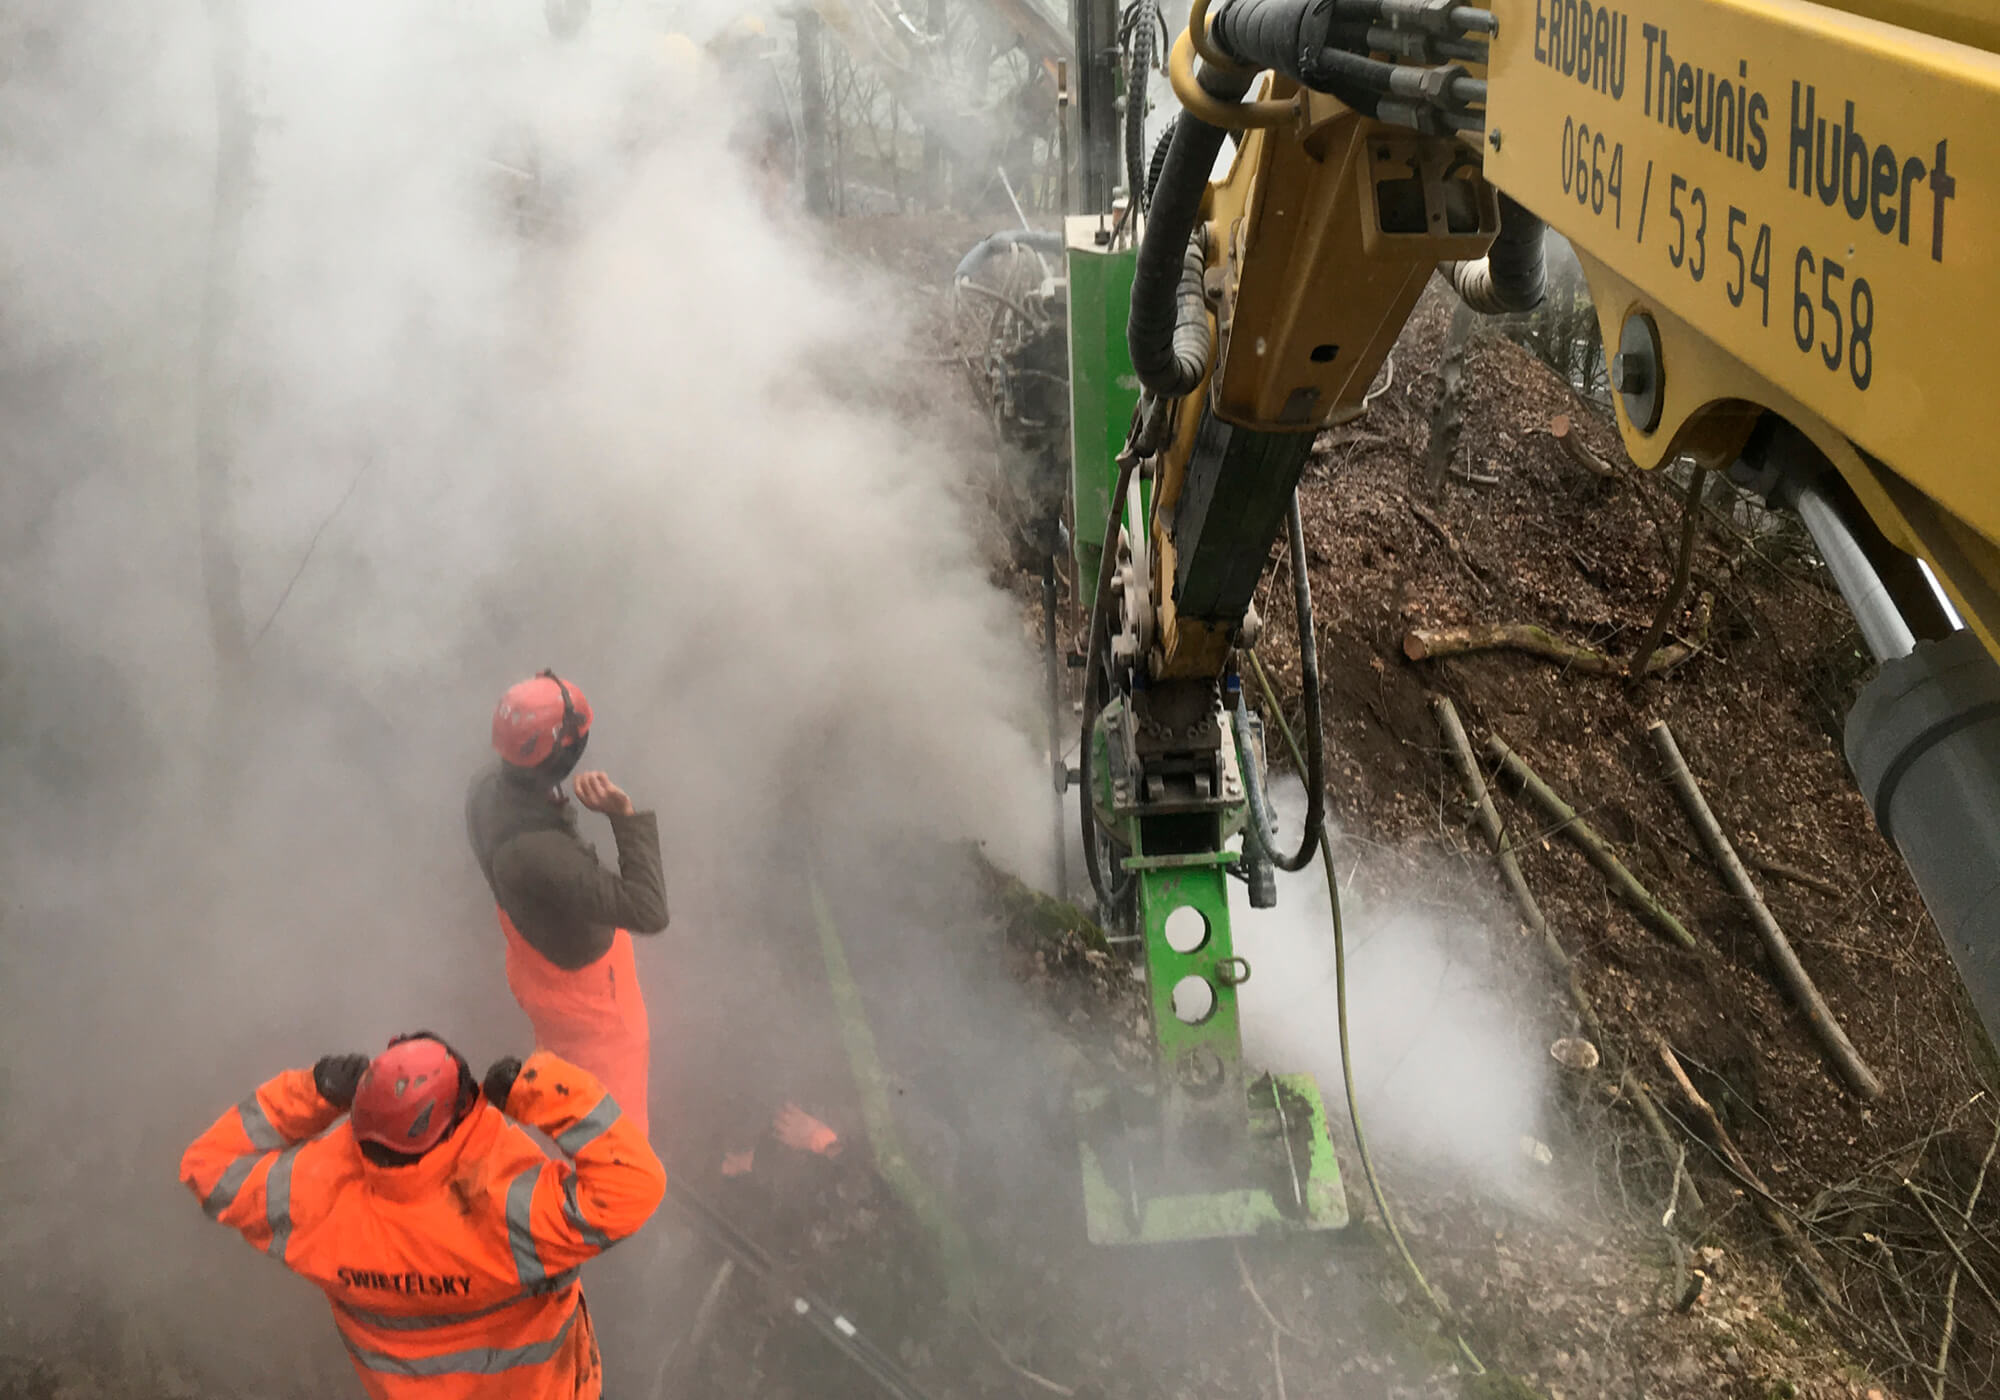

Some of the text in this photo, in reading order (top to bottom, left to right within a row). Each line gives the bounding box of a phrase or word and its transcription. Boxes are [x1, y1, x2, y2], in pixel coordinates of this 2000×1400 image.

[1534, 0, 1956, 263] ERDBAU Theunis Hubert
[1561, 115, 1874, 391] 0664 / 53 54 658
